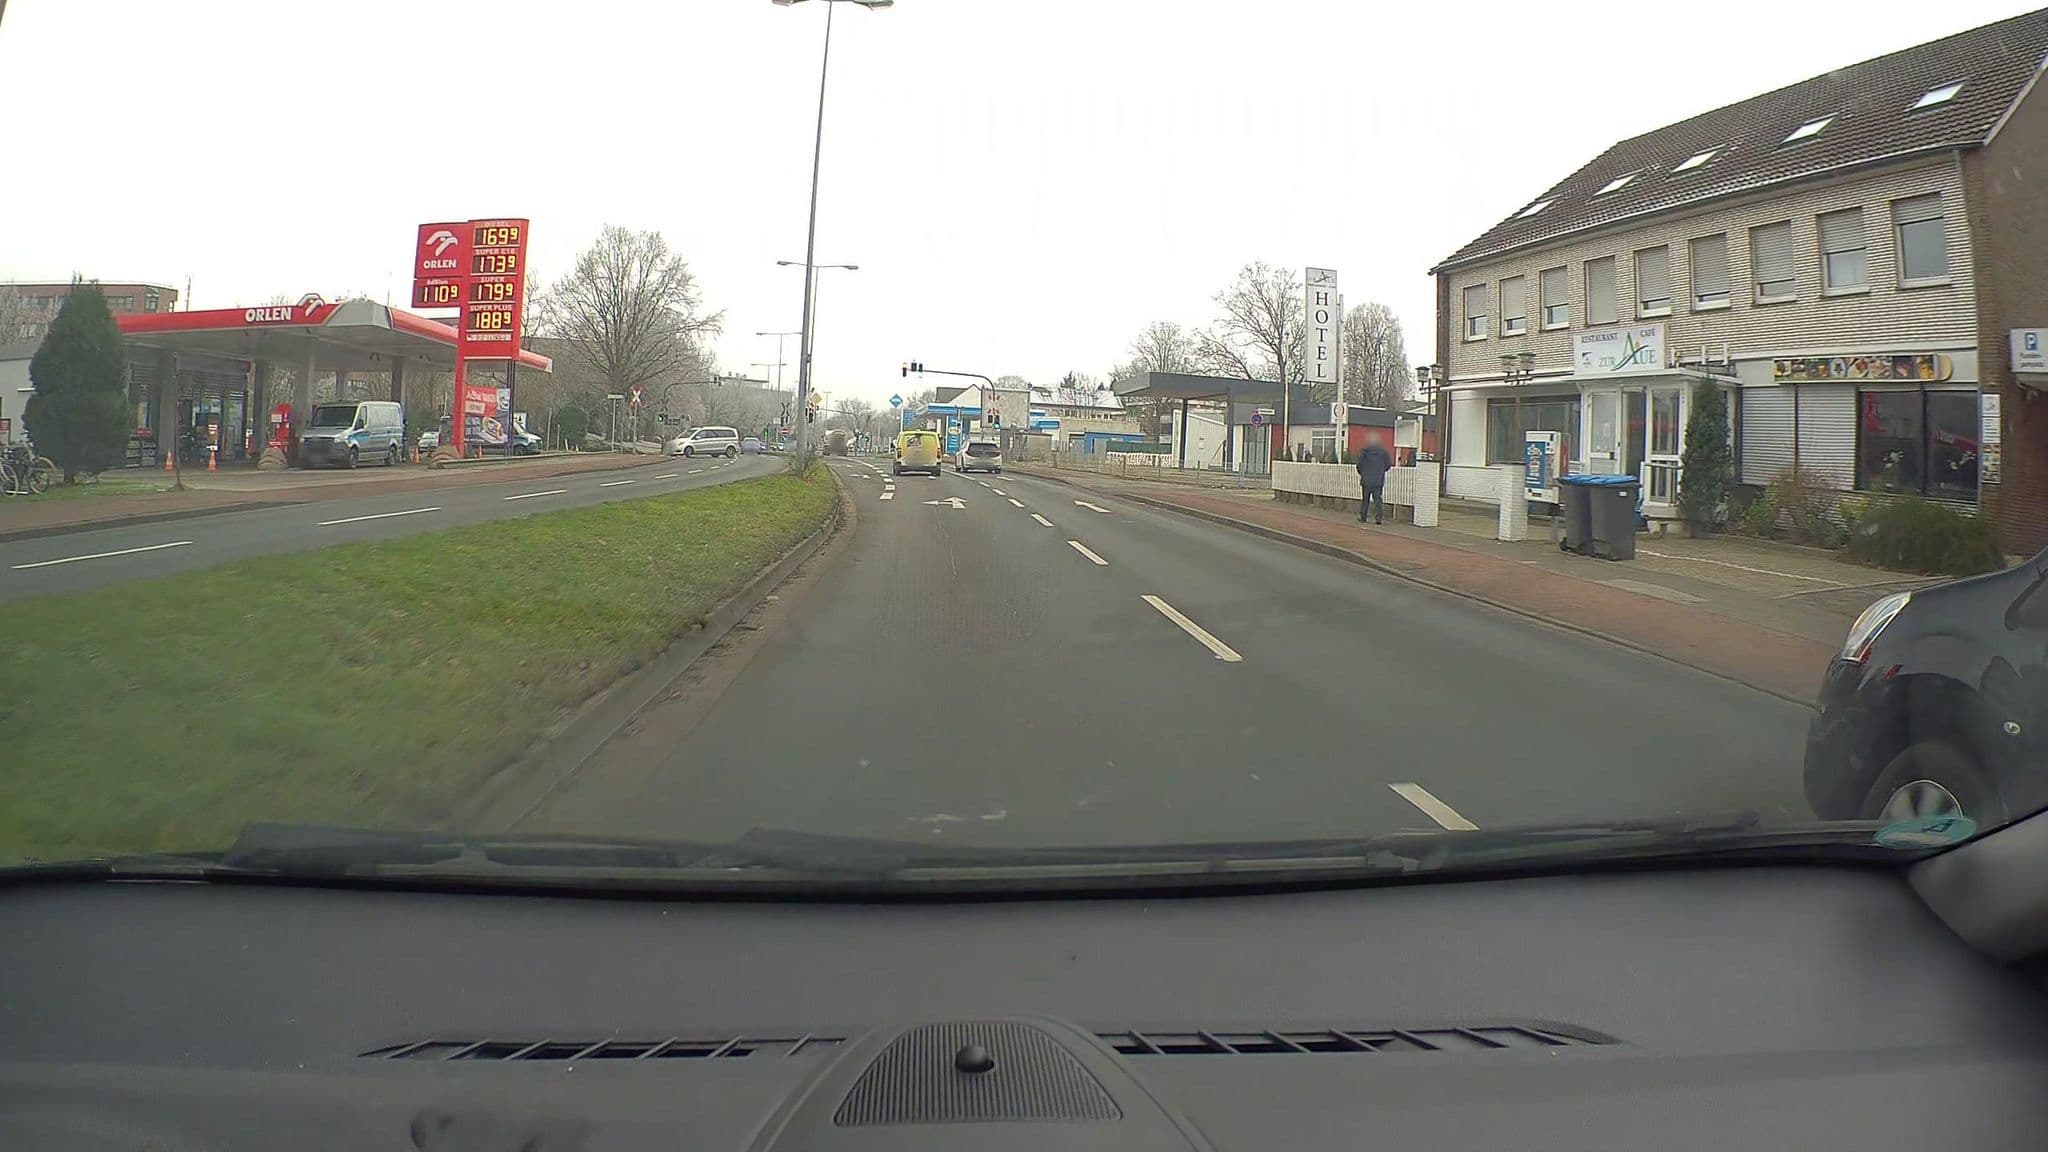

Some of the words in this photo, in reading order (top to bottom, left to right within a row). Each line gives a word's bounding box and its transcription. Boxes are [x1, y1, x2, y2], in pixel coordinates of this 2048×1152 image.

[423, 259, 457, 269] ORLEN
[245, 307, 292, 323] ORLEN
[1315, 291, 1329, 378] HOTEL
[1581, 333, 1618, 344] RESTAURANT
